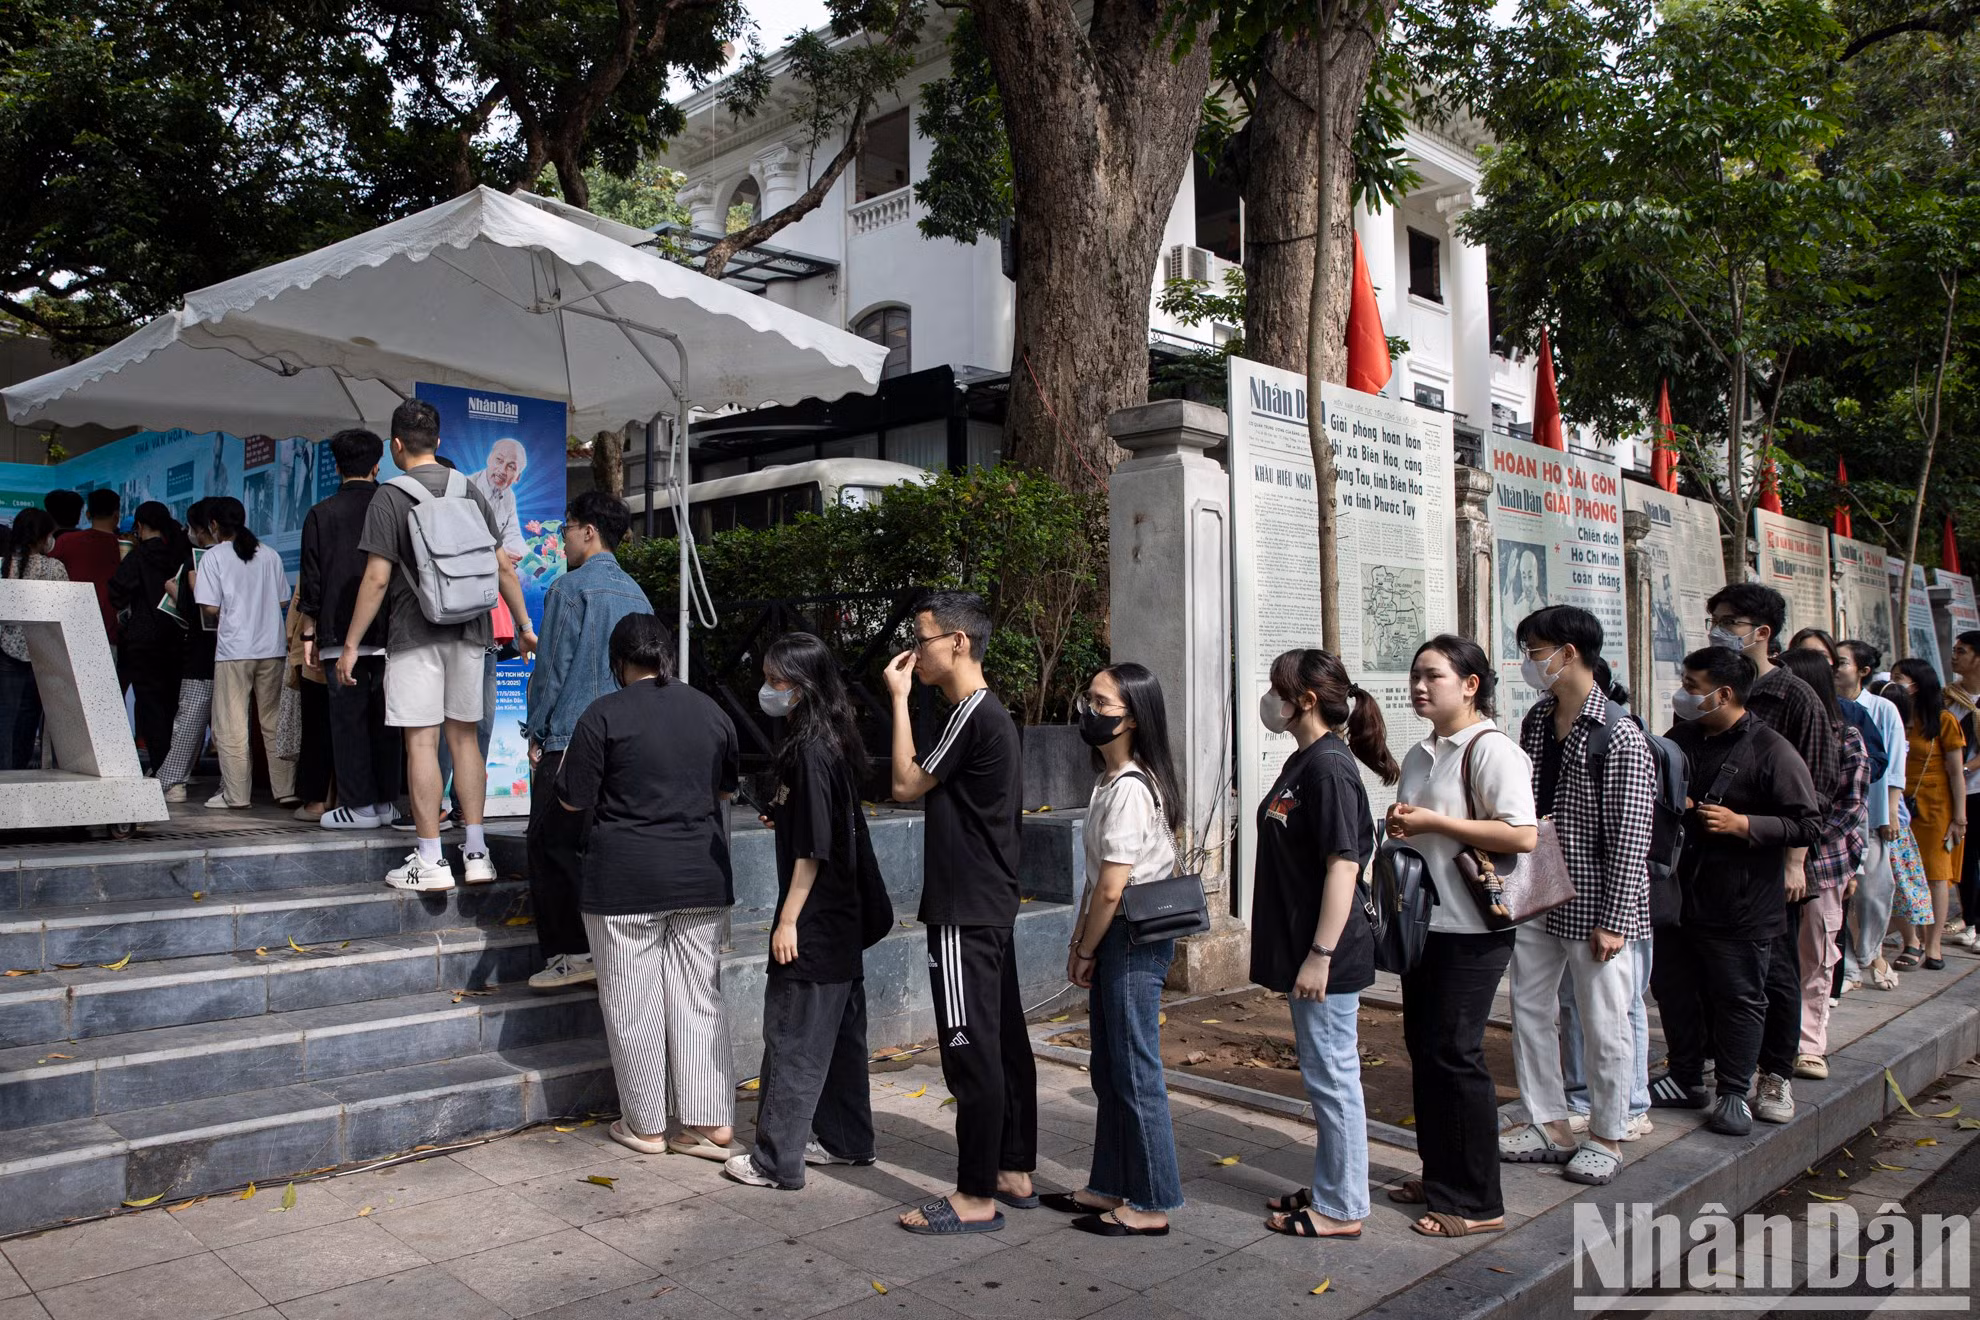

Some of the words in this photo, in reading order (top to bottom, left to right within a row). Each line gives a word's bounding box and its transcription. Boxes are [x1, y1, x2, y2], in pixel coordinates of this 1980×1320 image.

[469, 397, 496, 412] Nhân
[498, 400, 518, 416] Dân
[1250, 376, 1292, 417] Nhân
[1296, 388, 1326, 425] Dn
[1330, 414, 1347, 433] Giải
[1353, 420, 1377, 442] phóng
[1382, 426, 1400, 446] hoàn
[1406, 433, 1422, 450] toàn
[1347, 444, 1358, 458] xã
[1362, 444, 1379, 464] Biên
[1404, 457, 1422, 476] cảng
[1494, 449, 1537, 479] HOAN
[1542, 461, 1562, 484] HÔ
[1567, 465, 1586, 490] SÀI
[1592, 472, 1616, 496] GÒN
[1276, 468, 1292, 488] HIỆU
[1296, 472, 1312, 490] NGÀY
[1374, 472, 1388, 490] tỉnh
[1390, 475, 1406, 492] Biên
[1408, 478, 1422, 496] Hòa
[1342, 492, 1352, 506] và
[1356, 492, 1371, 510] tỉnh
[1374, 496, 1400, 514] Phước
[1402, 500, 1416, 520] Tuy
[1496, 483, 1522, 510] Nhân
[1523, 488, 1542, 514] Dân
[1544, 489, 1570, 516] GIẢI
[1576, 497, 1616, 524] PHÓNG
[1578, 528, 1600, 541] Chiến
[1603, 532, 1618, 546] dịch
[1571, 547, 1584, 562] Hồ
[1586, 551, 1599, 564] Chí
[1602, 552, 1620, 566] Minh
[1572, 570, 1592, 585] toàn
[1598, 572, 1620, 592] thắng
